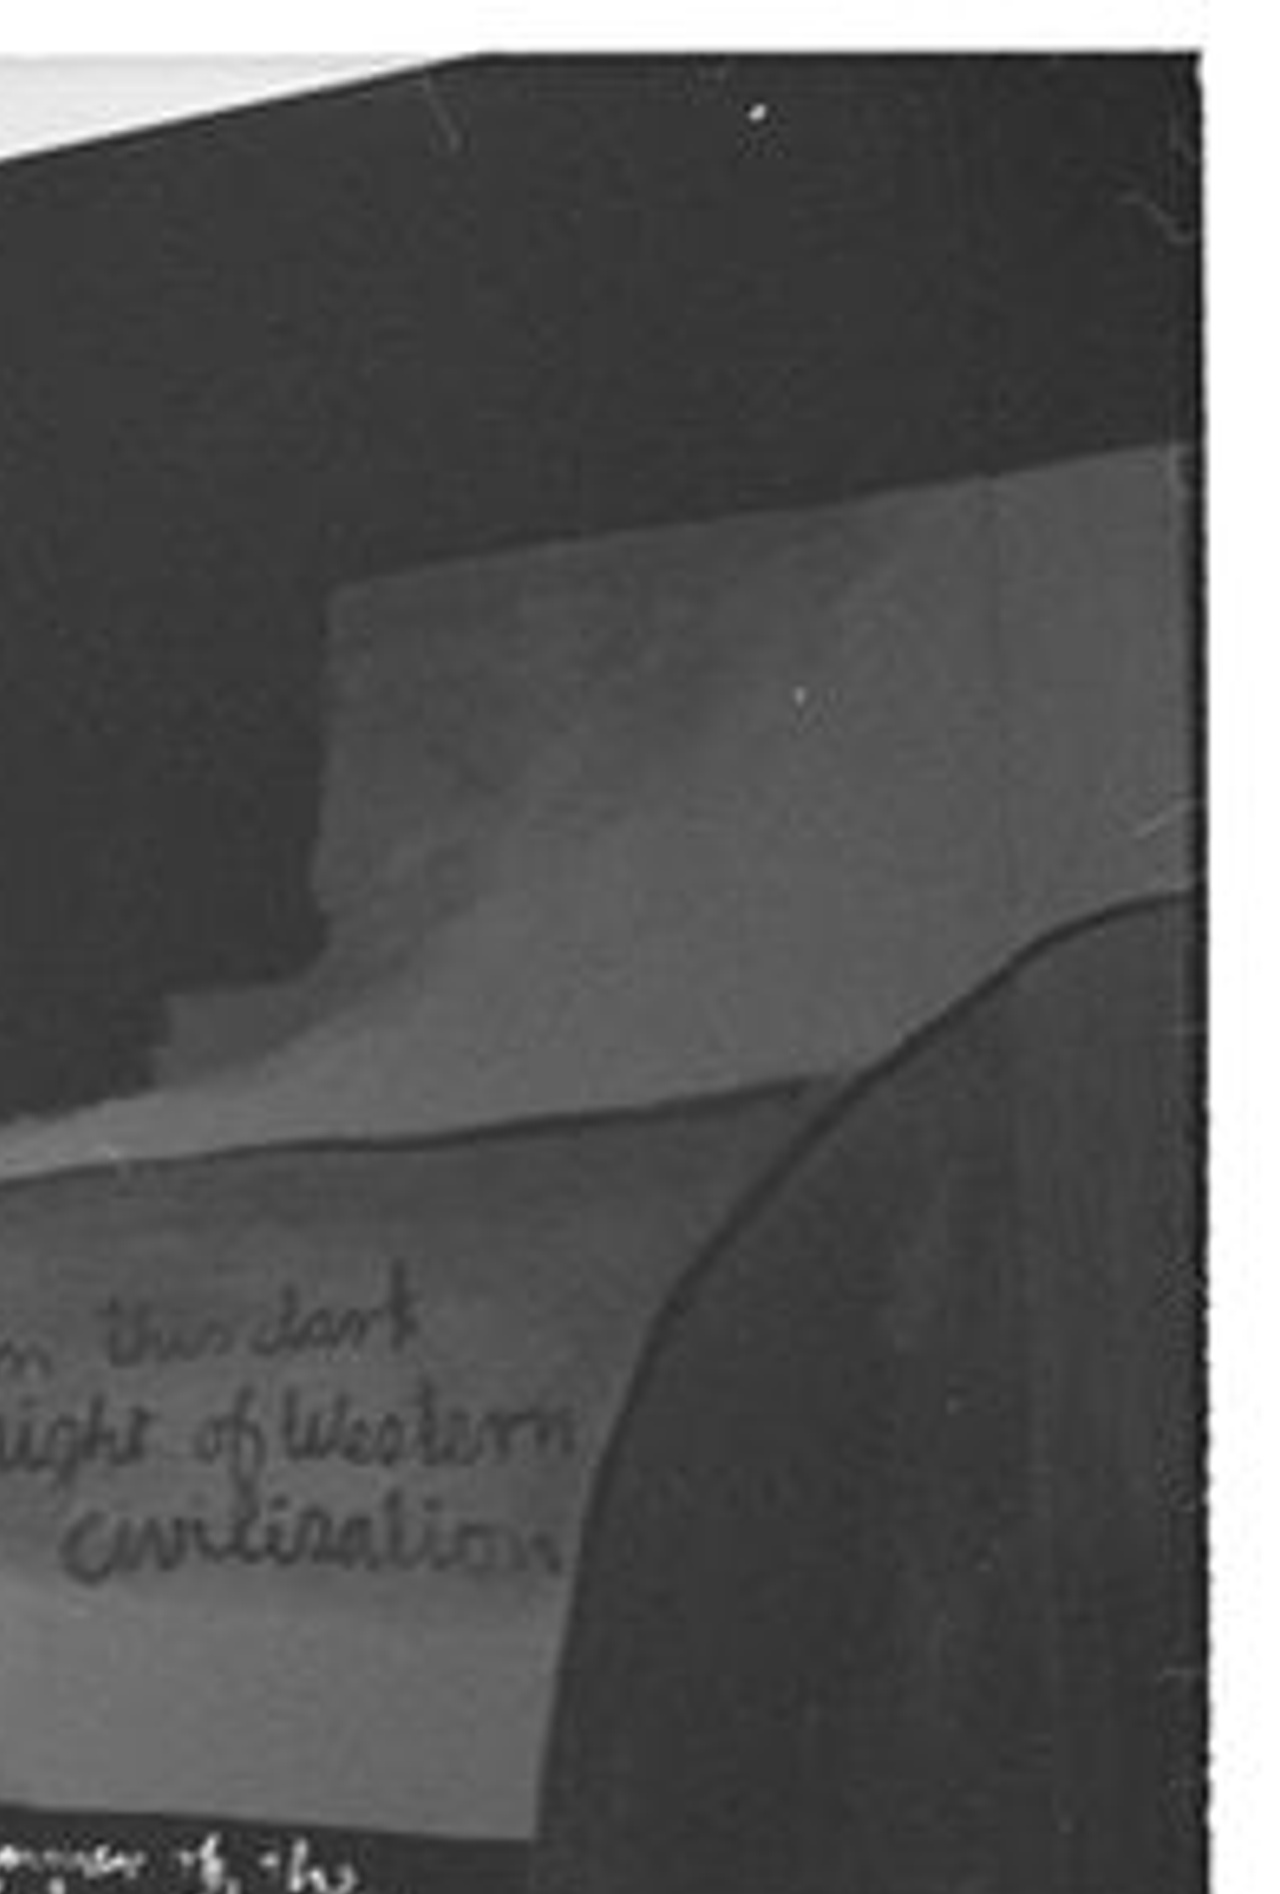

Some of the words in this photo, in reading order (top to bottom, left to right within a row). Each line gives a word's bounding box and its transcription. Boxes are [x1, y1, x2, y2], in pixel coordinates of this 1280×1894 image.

[94, 1295, 232, 1370] this
[248, 1256, 419, 1356] dark
[191, 1383, 265, 1500] of
[278, 1374, 578, 1468] Western
